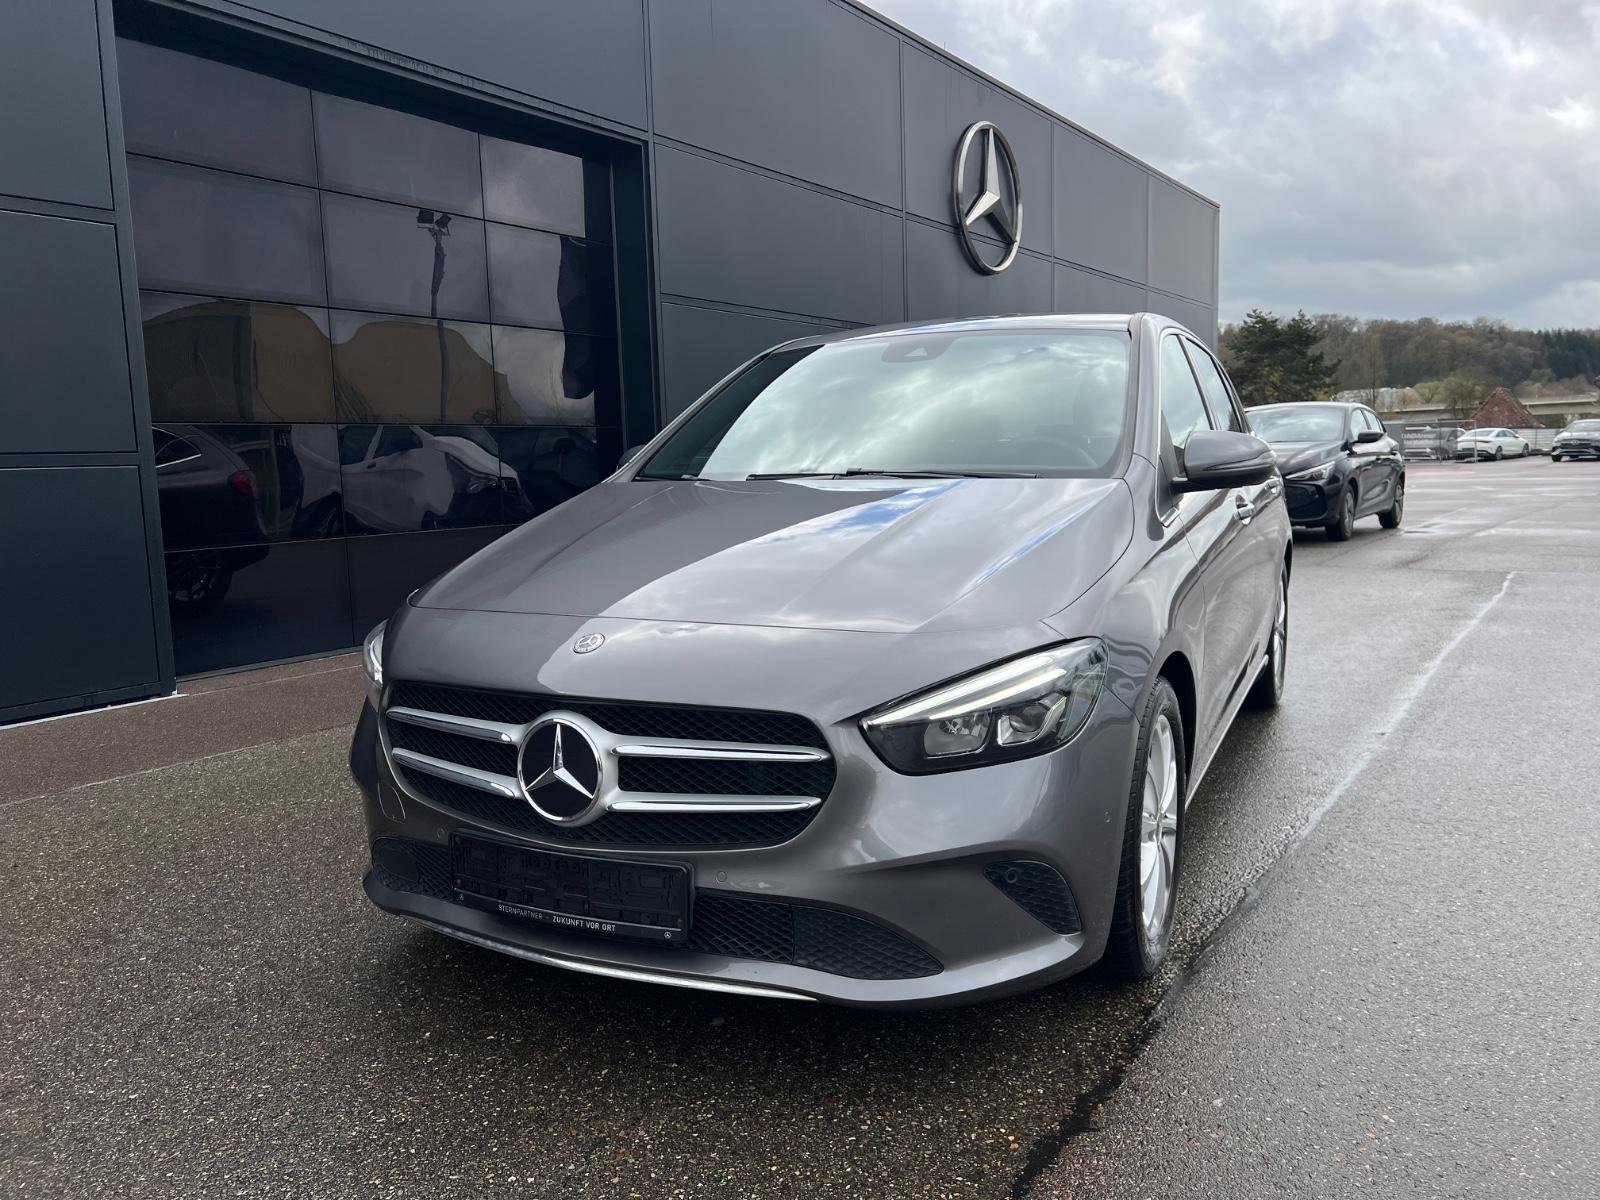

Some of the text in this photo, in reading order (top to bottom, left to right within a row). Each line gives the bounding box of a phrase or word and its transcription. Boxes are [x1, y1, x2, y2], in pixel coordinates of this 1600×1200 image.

[498, 904, 616, 932] STERNPARTNER ZUKUNFT VOR ORT
